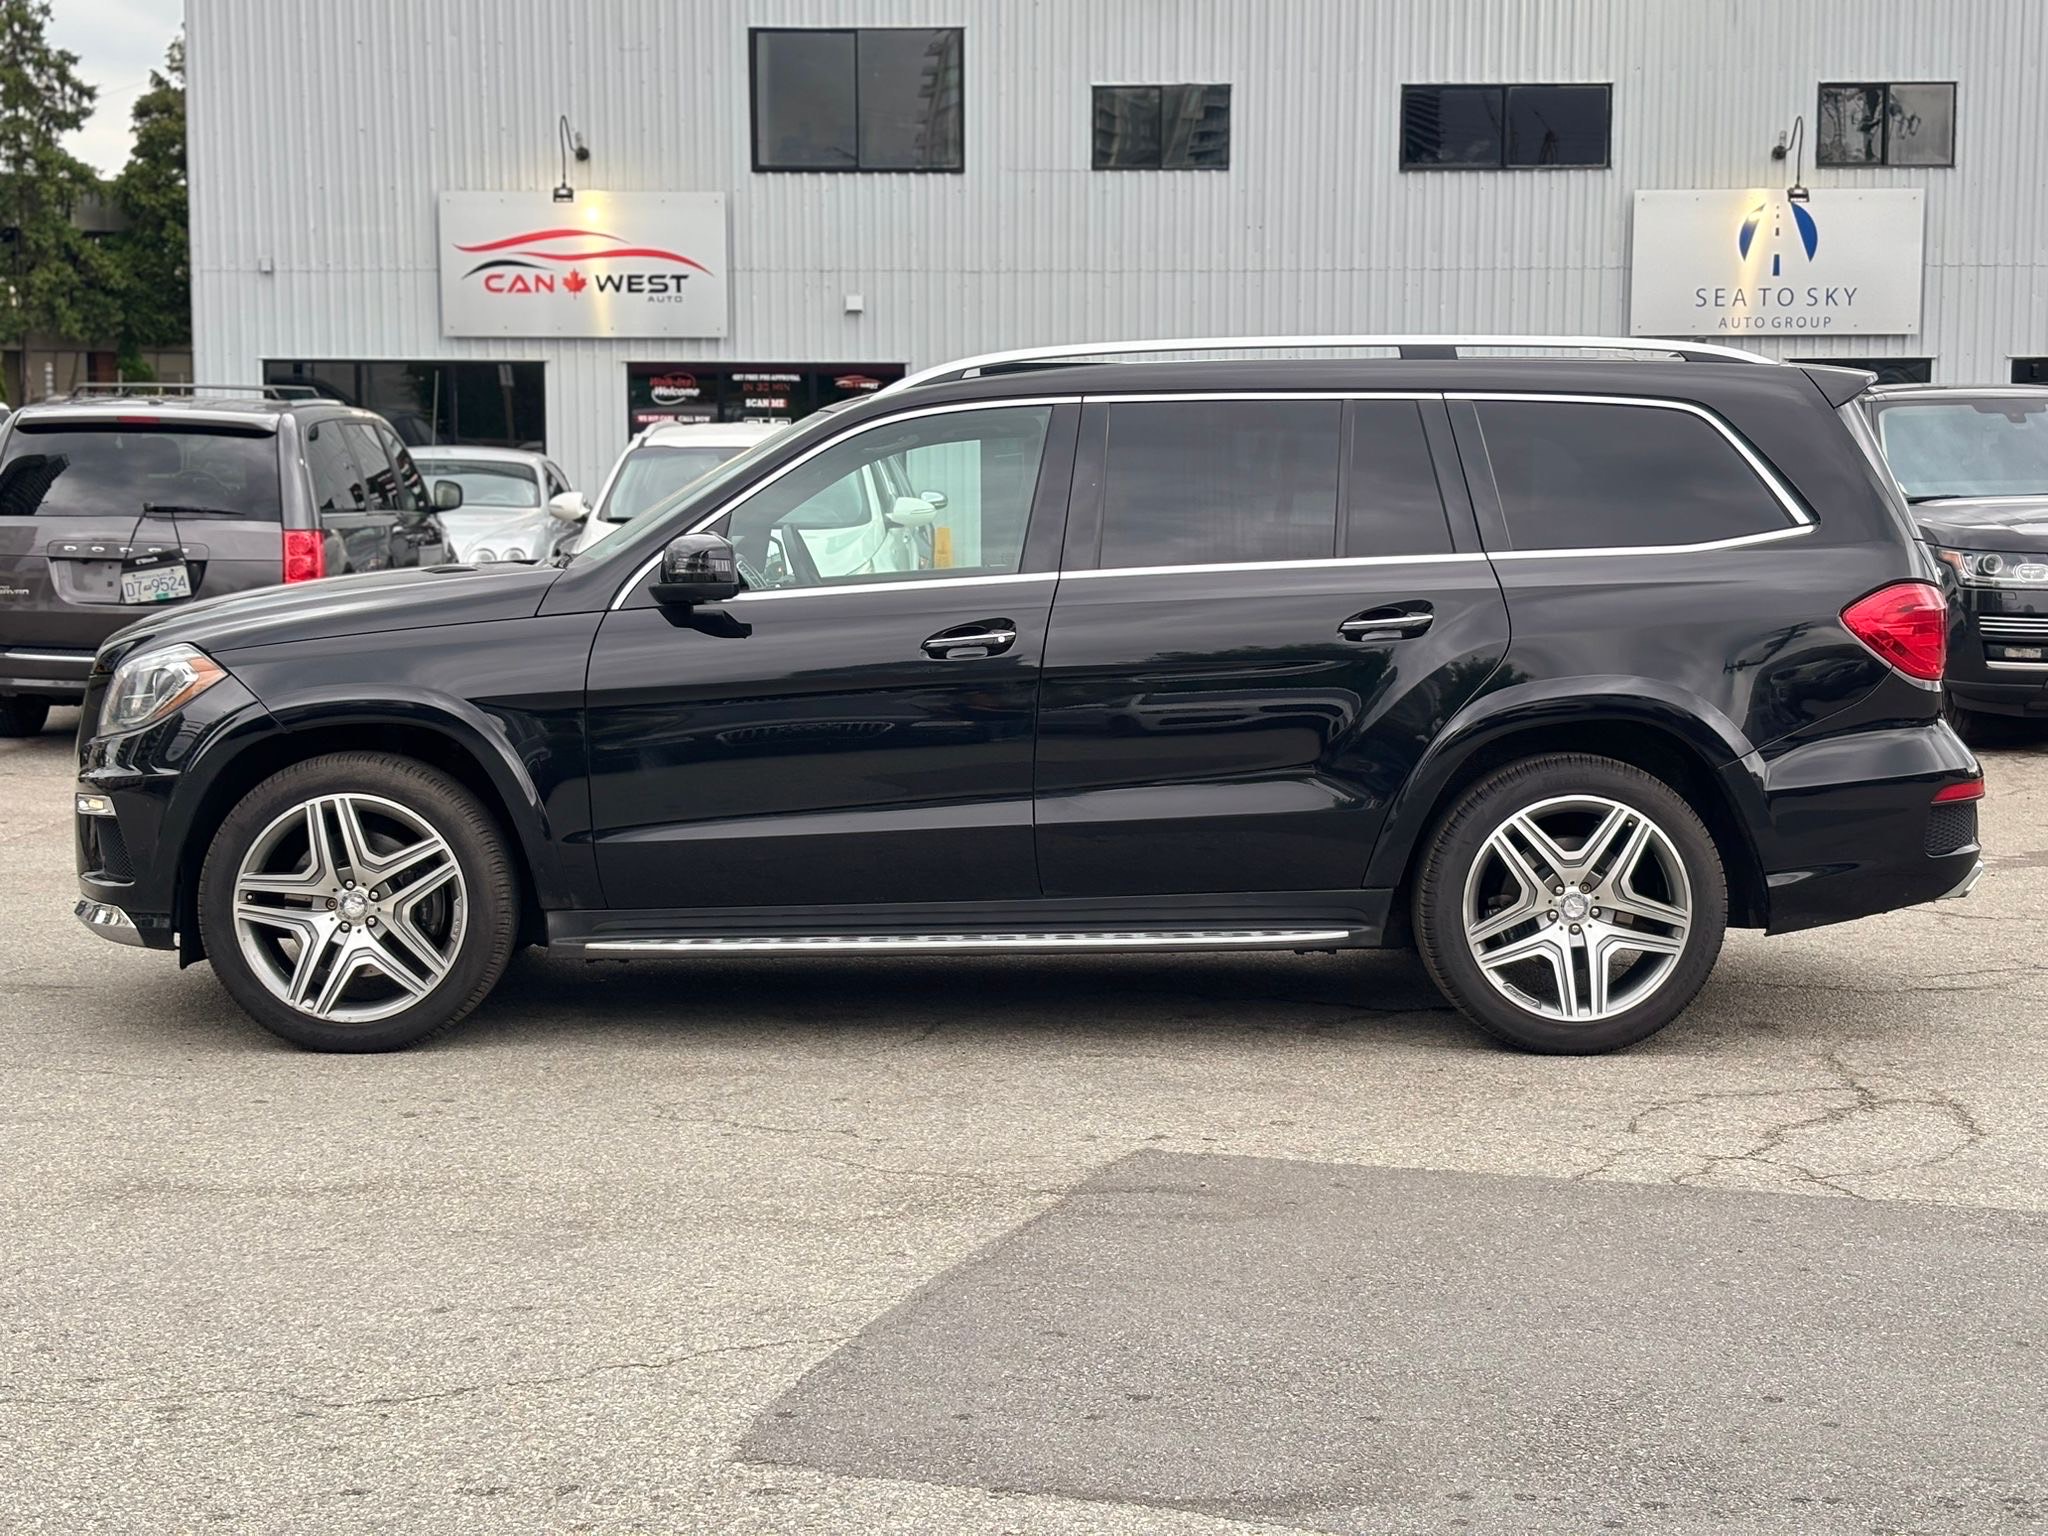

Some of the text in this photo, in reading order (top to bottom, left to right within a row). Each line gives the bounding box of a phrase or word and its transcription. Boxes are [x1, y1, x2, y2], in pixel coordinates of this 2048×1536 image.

[484, 274, 690, 293] CAN WEST
[647, 295, 683, 303] AUTO
[1695, 286, 1858, 307] SEA TO SKY
[1718, 316, 1832, 329] AUTO GROUP
[653, 386, 700, 397] Welcome
[745, 398, 769, 408] SCAN
